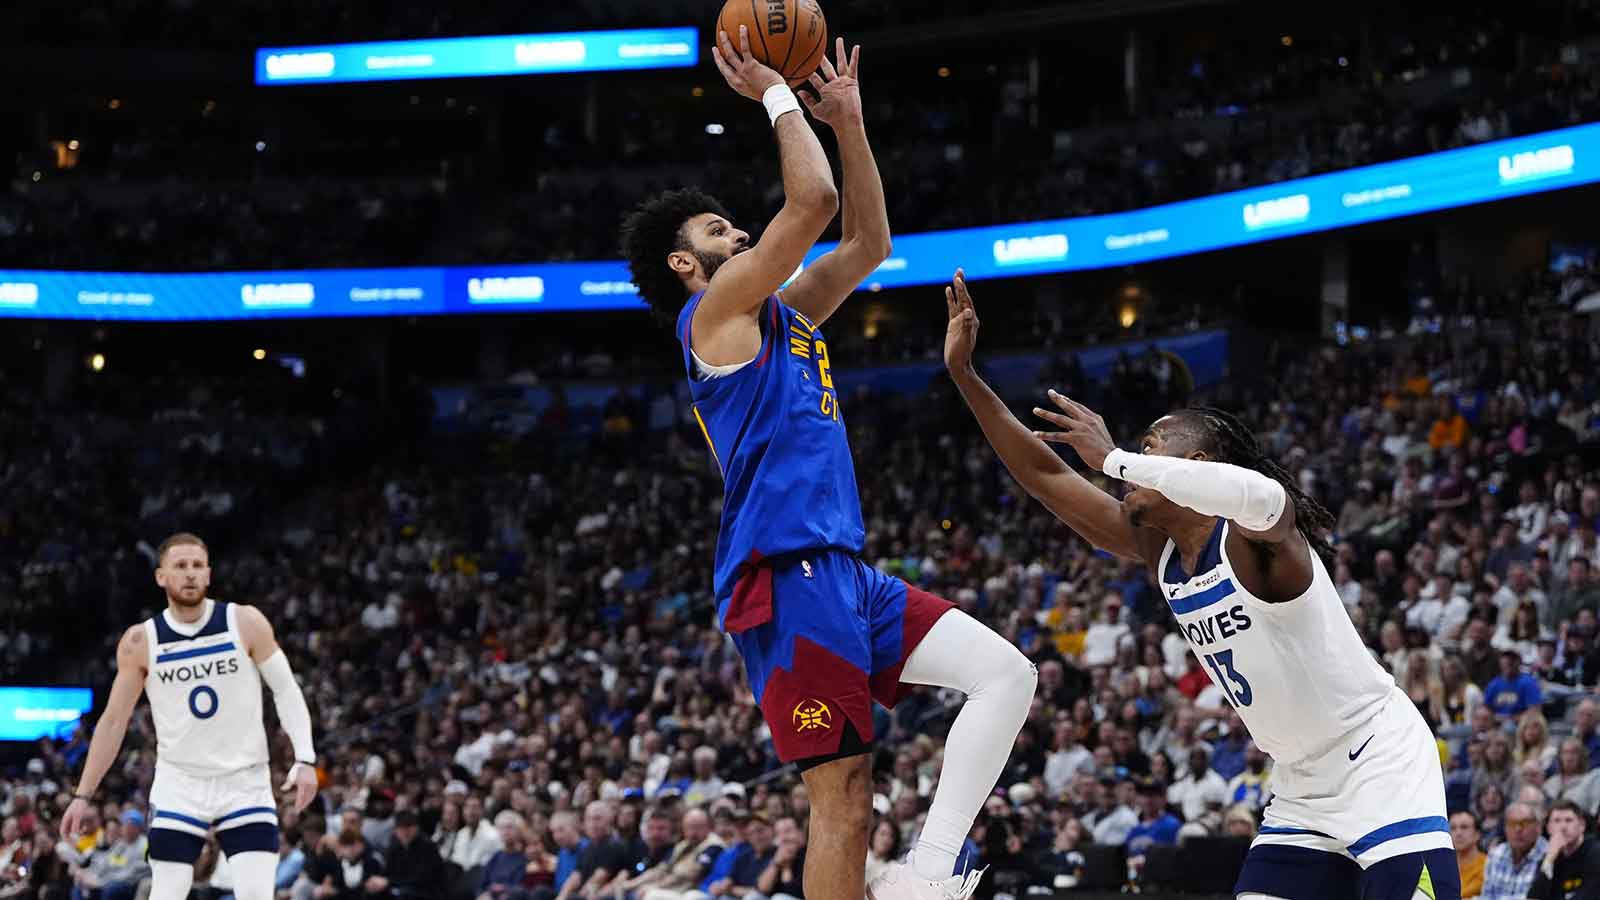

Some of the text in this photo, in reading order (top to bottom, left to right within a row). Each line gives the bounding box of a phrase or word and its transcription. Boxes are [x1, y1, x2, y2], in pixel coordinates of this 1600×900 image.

[789, 311, 818, 359] MIL
[815, 339, 833, 389] 2
[820, 391, 840, 423] CI
[158, 657, 239, 684] WOLVES
[1203, 648, 1253, 708] 13
[188, 685, 219, 720] 0
